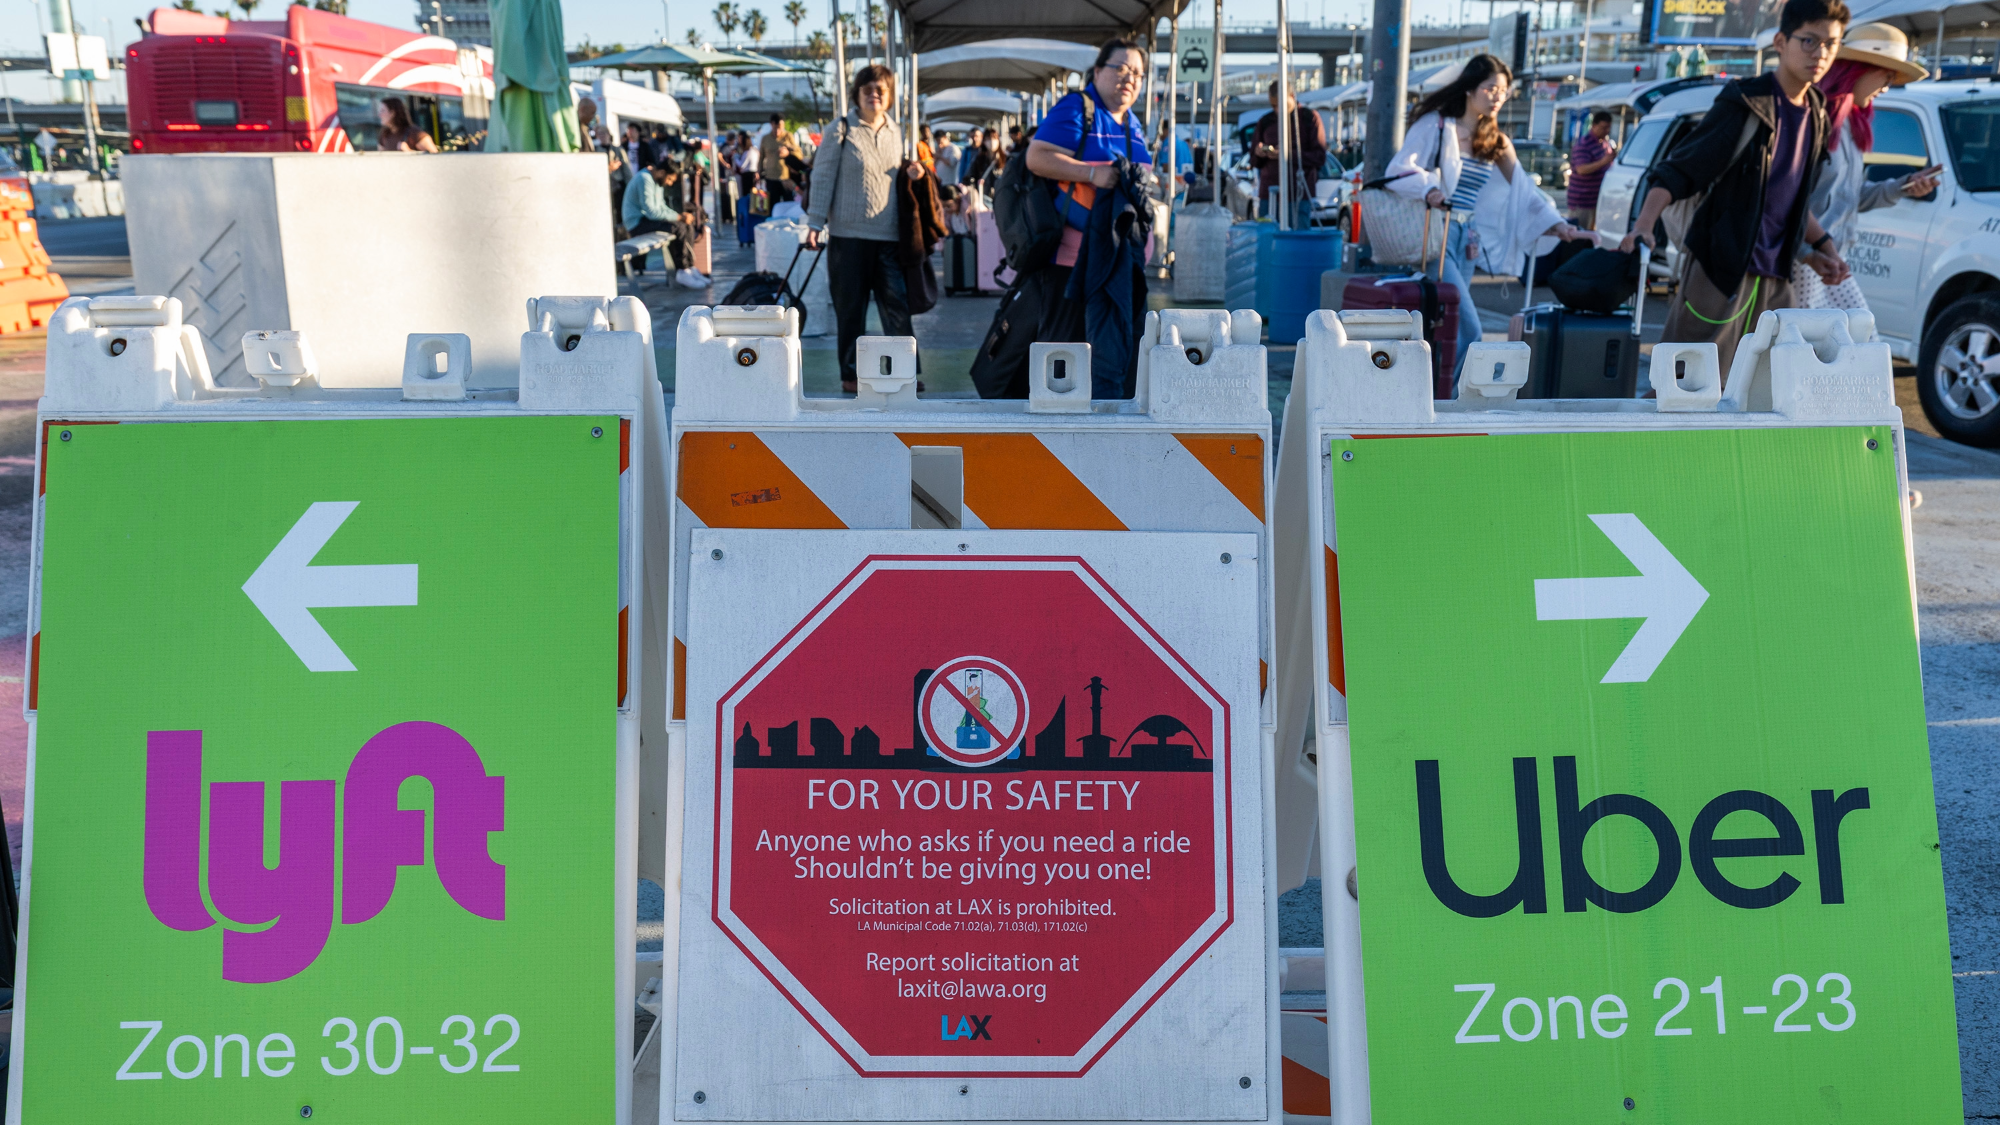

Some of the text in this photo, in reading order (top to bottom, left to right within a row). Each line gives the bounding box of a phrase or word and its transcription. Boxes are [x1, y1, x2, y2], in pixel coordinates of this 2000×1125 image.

[1184, 36, 1208, 45] TAXI
[1978, 217, 2000, 236] AT
[1855, 231, 1896, 248] ORIZED
[535, 363, 615, 374] ROADMARKER
[1803, 375, 1880, 386] ROADMARKER
[1171, 377, 1250, 388] ROADMARKER
[808, 779, 1140, 811] FOR YOUR SAFETY
[756, 829, 1191, 858] Anyone who asks if you need a ride
[1415, 755, 1870, 918] Uber
[143, 720, 506, 984] lyft
[922, 857, 952, 880] be
[960, 857, 1035, 885] giving
[1044, 862, 1089, 885] you
[1097, 858, 1151, 880] one!
[829, 898, 1117, 919] Solicitation at LAX is prohibited.
[857, 921, 1088, 933] LA Municipal Code 71.02(a), 71.03(d), 171.02(c)
[866, 952, 1079, 975] Report solicitation at
[898, 978, 1047, 1003] laxit@lawa.org
[1454, 972, 1857, 1044] Zone 21-23
[941, 1014, 993, 1041] LAX
[116, 1014, 521, 1081] Zone 30-32
